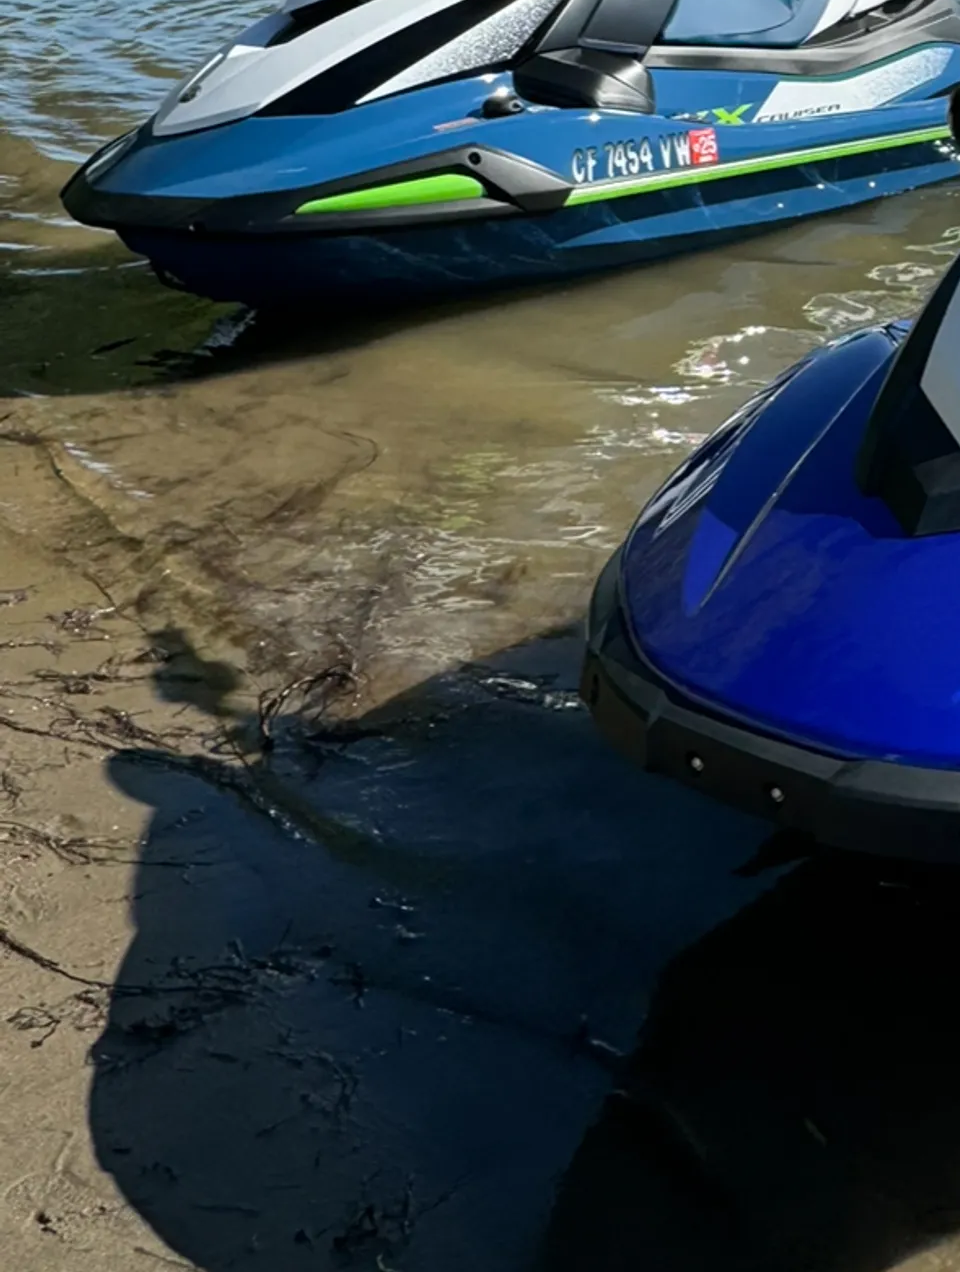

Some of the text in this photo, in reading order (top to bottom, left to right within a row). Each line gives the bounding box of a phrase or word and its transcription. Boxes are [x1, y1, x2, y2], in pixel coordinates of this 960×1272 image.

[572, 131, 691, 183] CF 7454 VW
